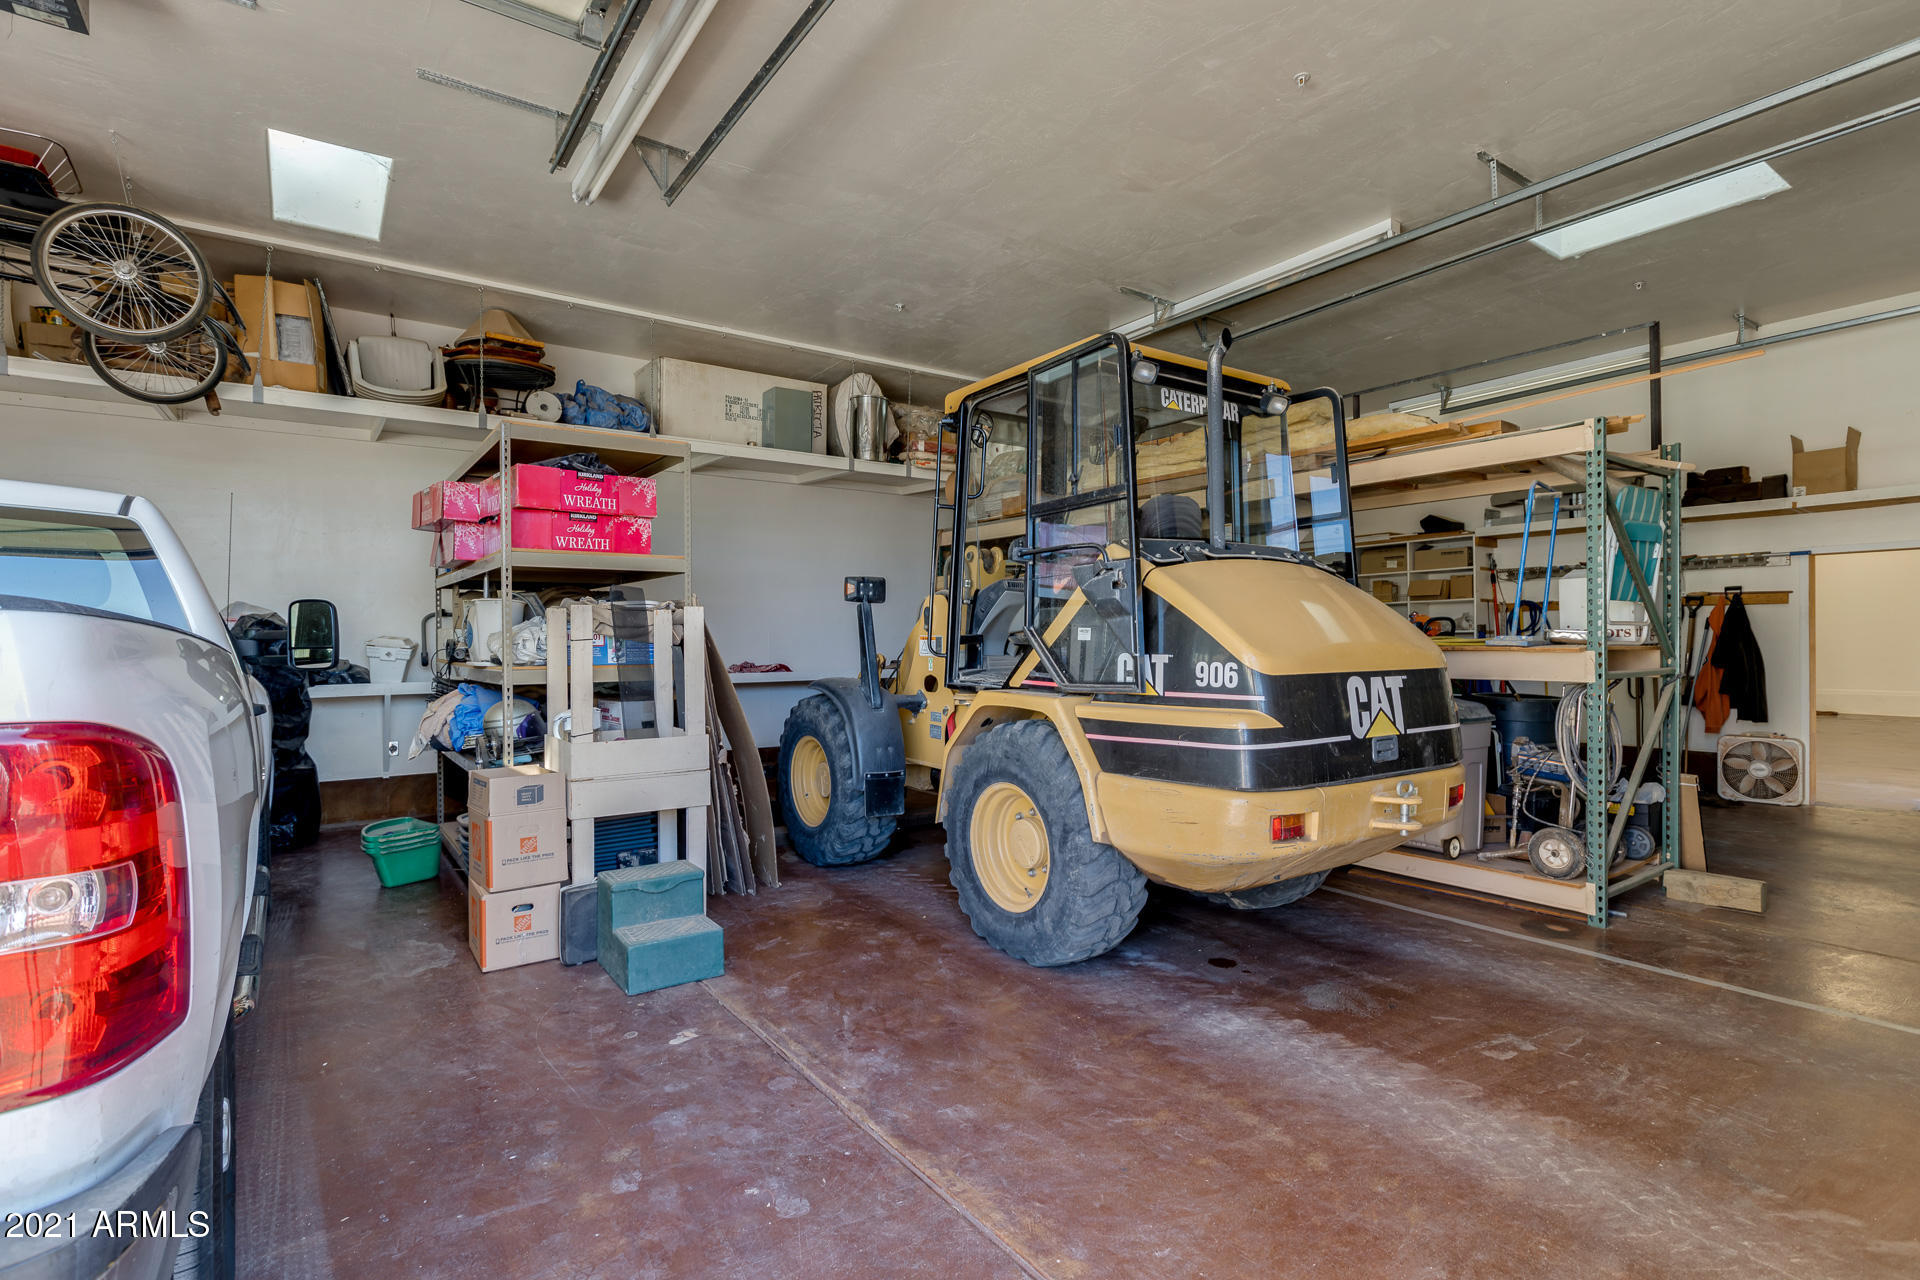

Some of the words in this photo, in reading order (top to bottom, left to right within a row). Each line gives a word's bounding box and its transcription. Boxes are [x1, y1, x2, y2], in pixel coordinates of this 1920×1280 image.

[1161, 387, 1239, 424] CATERPAR
[578, 472, 604, 480] KIRKLAND
[575, 483, 602, 496] Holiday
[563, 494, 617, 510] WREATH
[567, 524, 595, 537] Holiday
[555, 536, 610, 550] WREATH
[1195, 661, 1239, 688] 906
[1347, 675, 1405, 739] CAT
